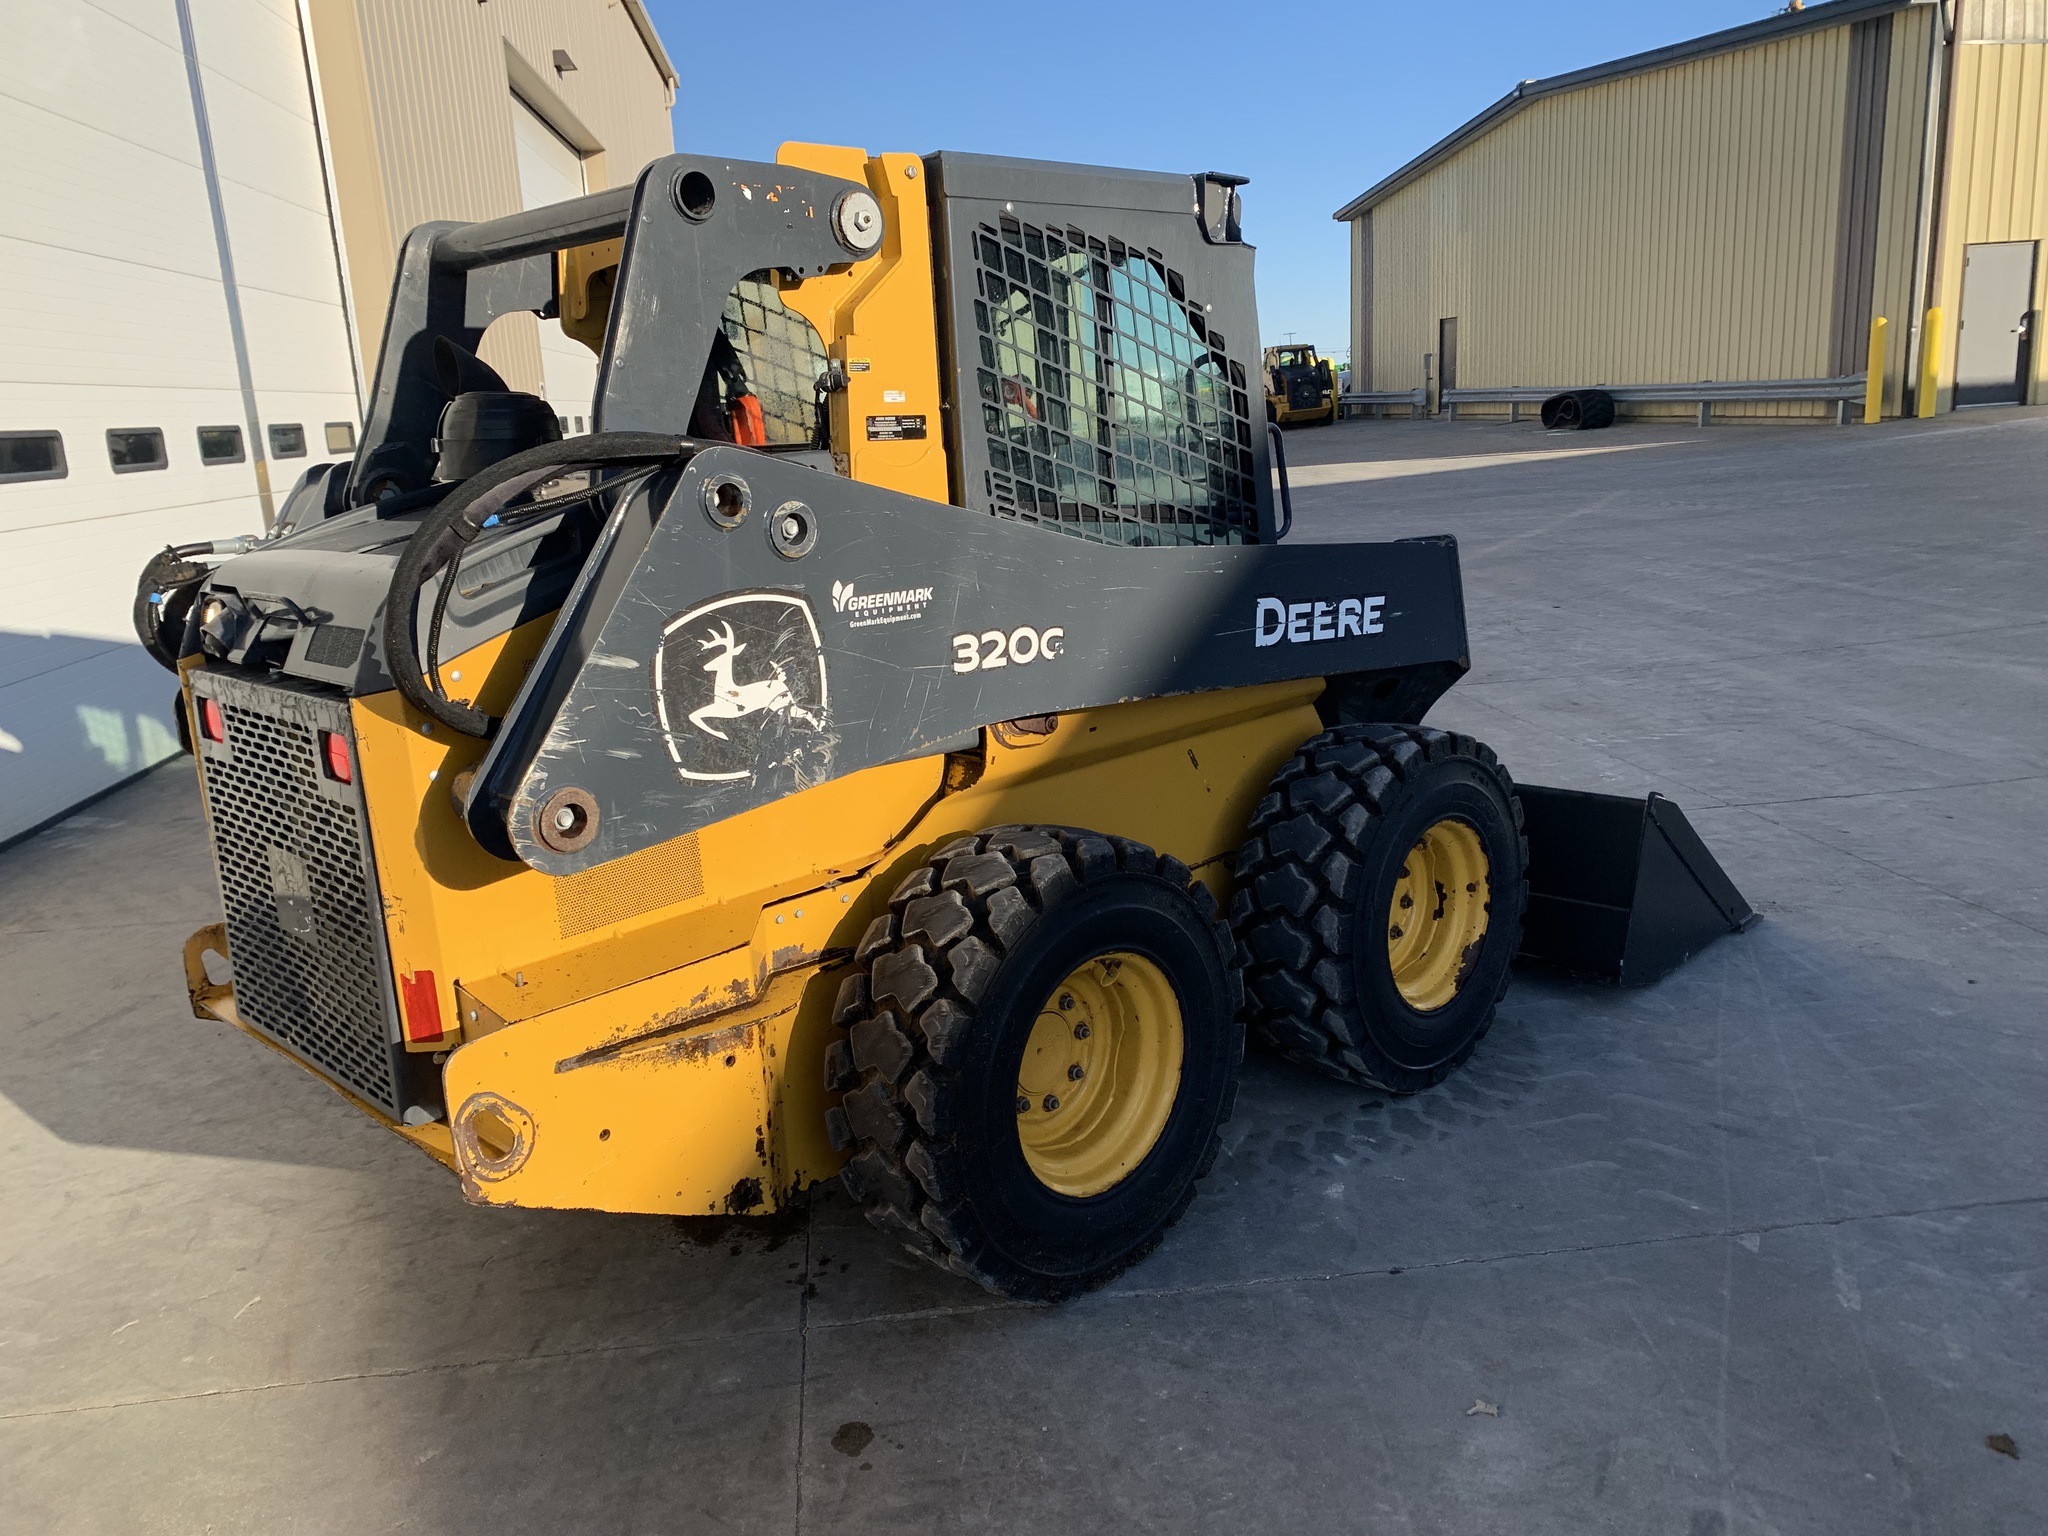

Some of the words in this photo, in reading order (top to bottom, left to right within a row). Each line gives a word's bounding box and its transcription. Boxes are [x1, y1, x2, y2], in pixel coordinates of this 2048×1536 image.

[848, 587, 934, 611] GREENMARK
[849, 612, 922, 628] GreenMarkEquipment.com
[855, 602, 927, 618] EQUIPMENT
[1255, 596, 1386, 648] DEERE
